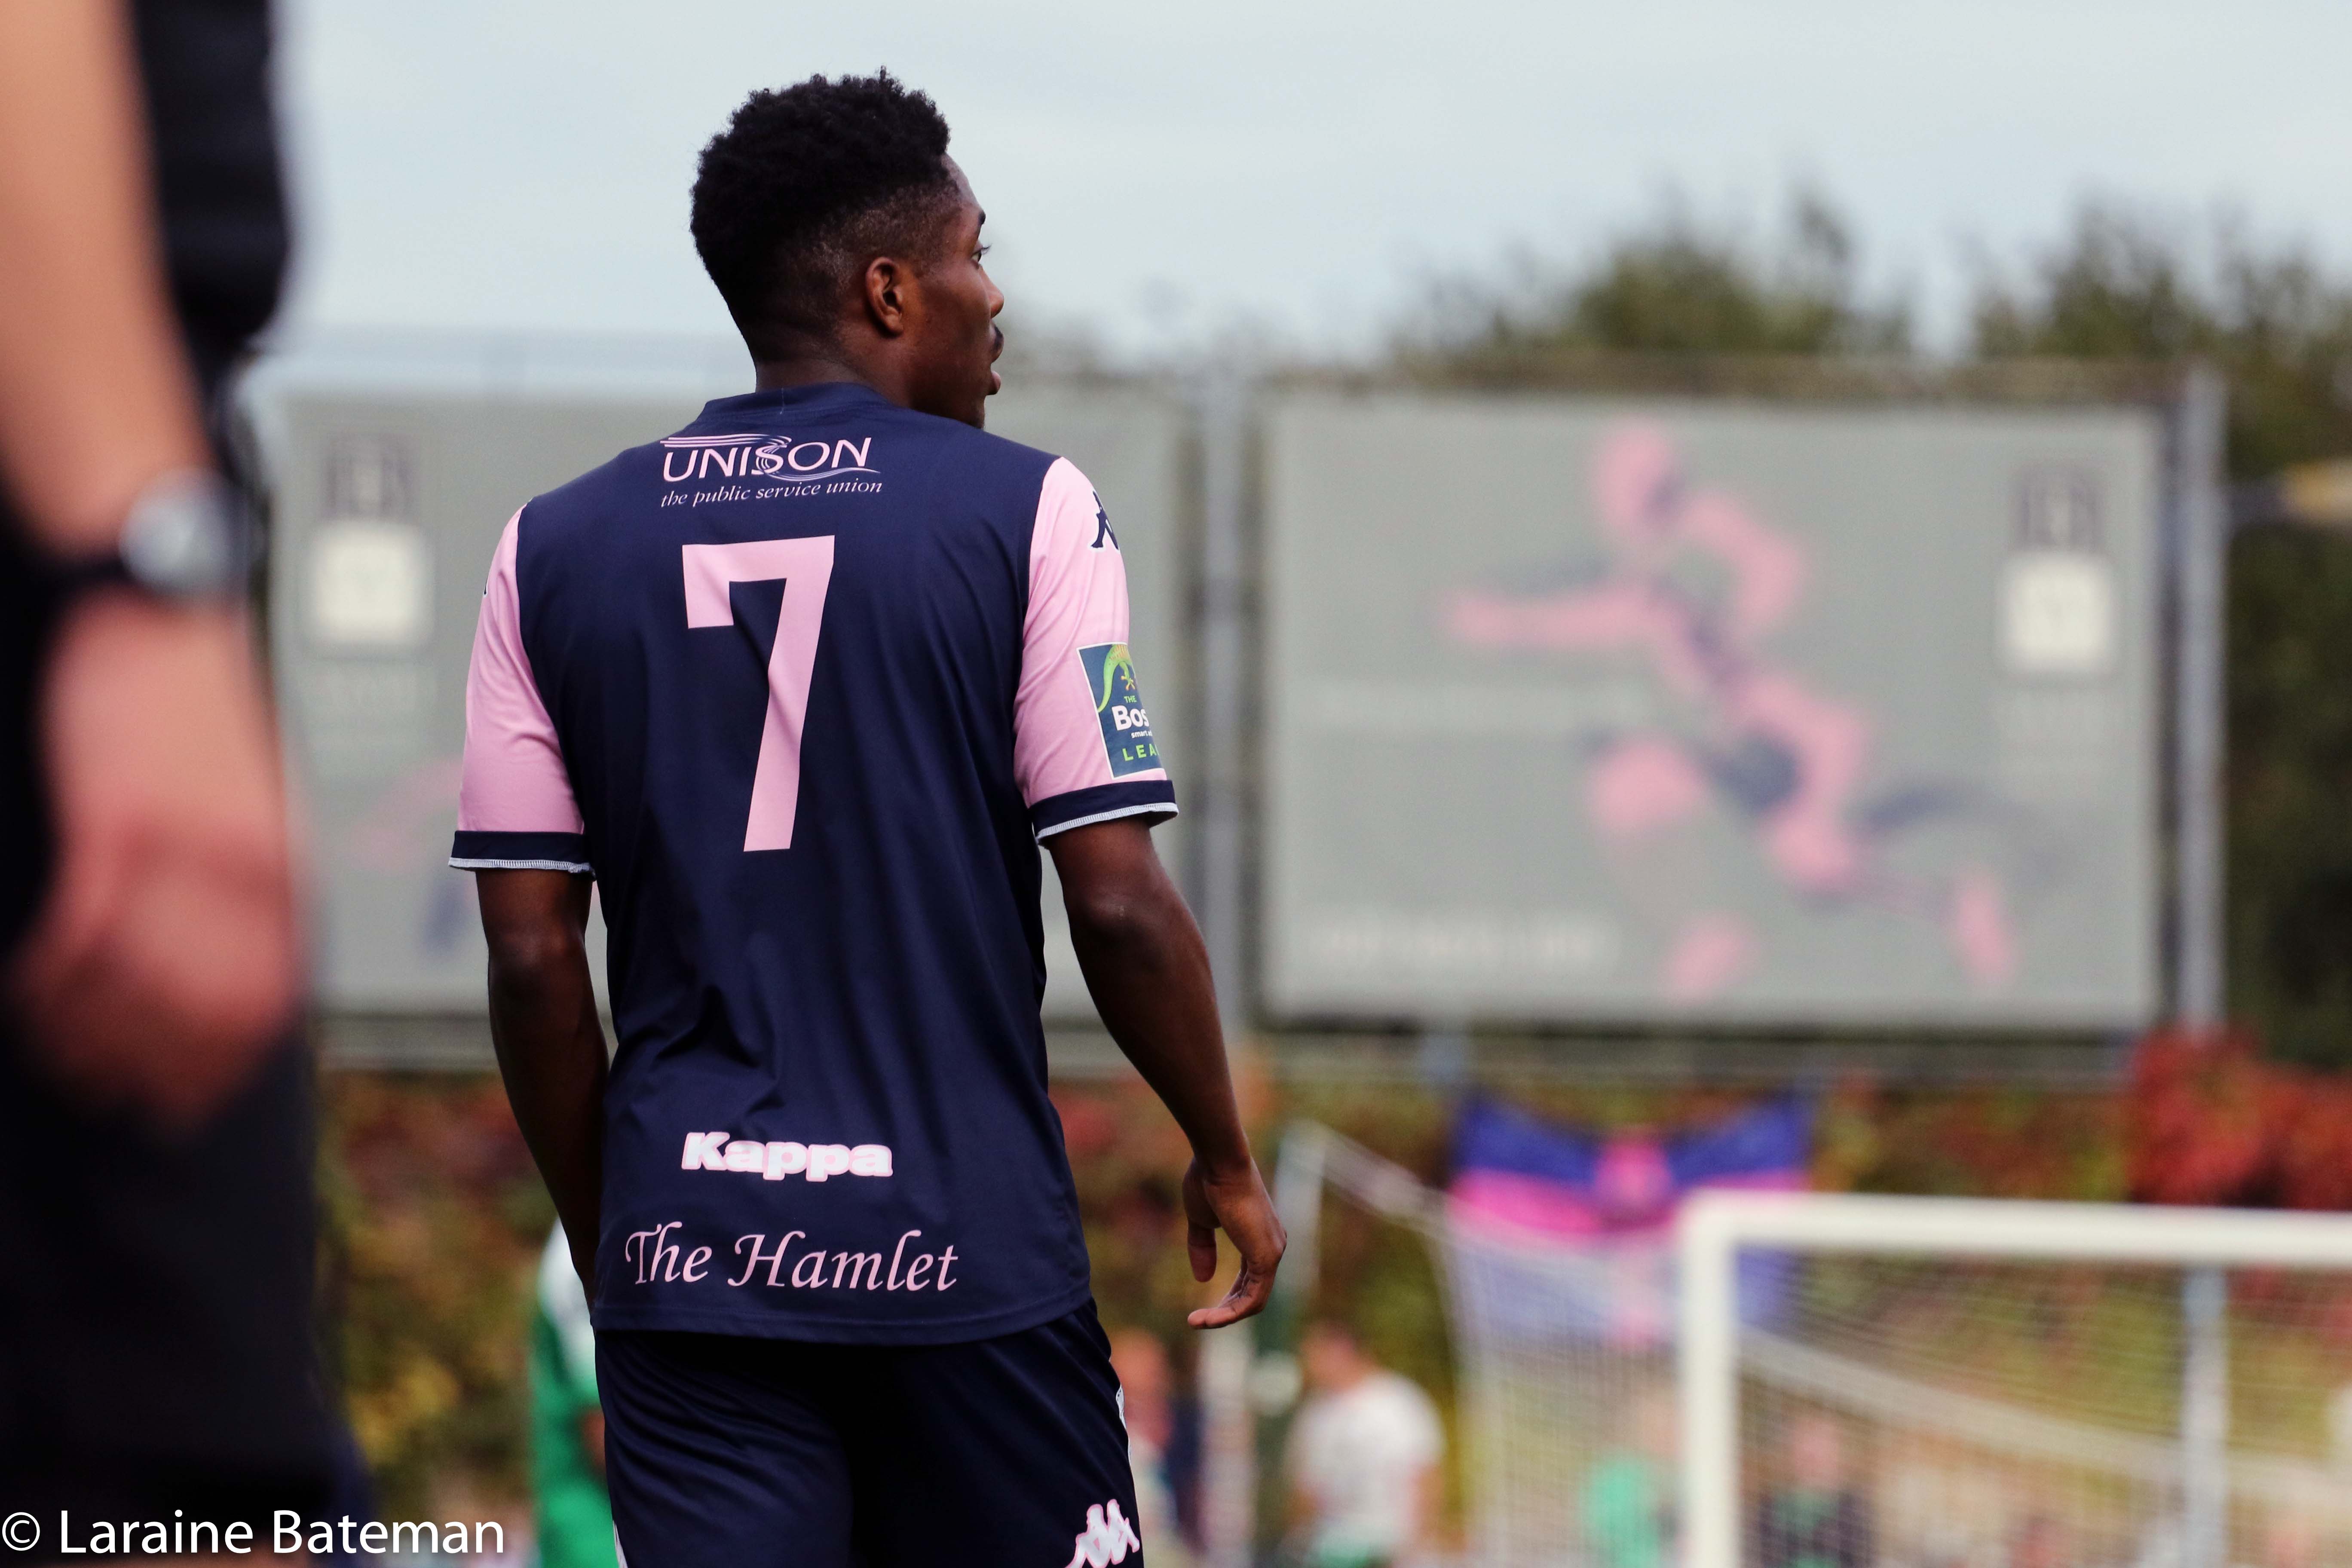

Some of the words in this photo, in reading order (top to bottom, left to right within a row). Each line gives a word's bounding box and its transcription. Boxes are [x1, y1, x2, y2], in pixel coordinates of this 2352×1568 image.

[662, 436, 872, 482] UNISON
[661, 490, 688, 508] the
[692, 485, 751, 508] public
[755, 481, 821, 499] service
[826, 477, 883, 495] union
[682, 535, 835, 852] 7
[1124, 695, 1137, 703] THE
[1122, 743, 1160, 762] LEA
[681, 1132, 893, 1182] Kappa
[625, 1221, 713, 1285] The
[727, 1230, 959, 1291] Hamlet
